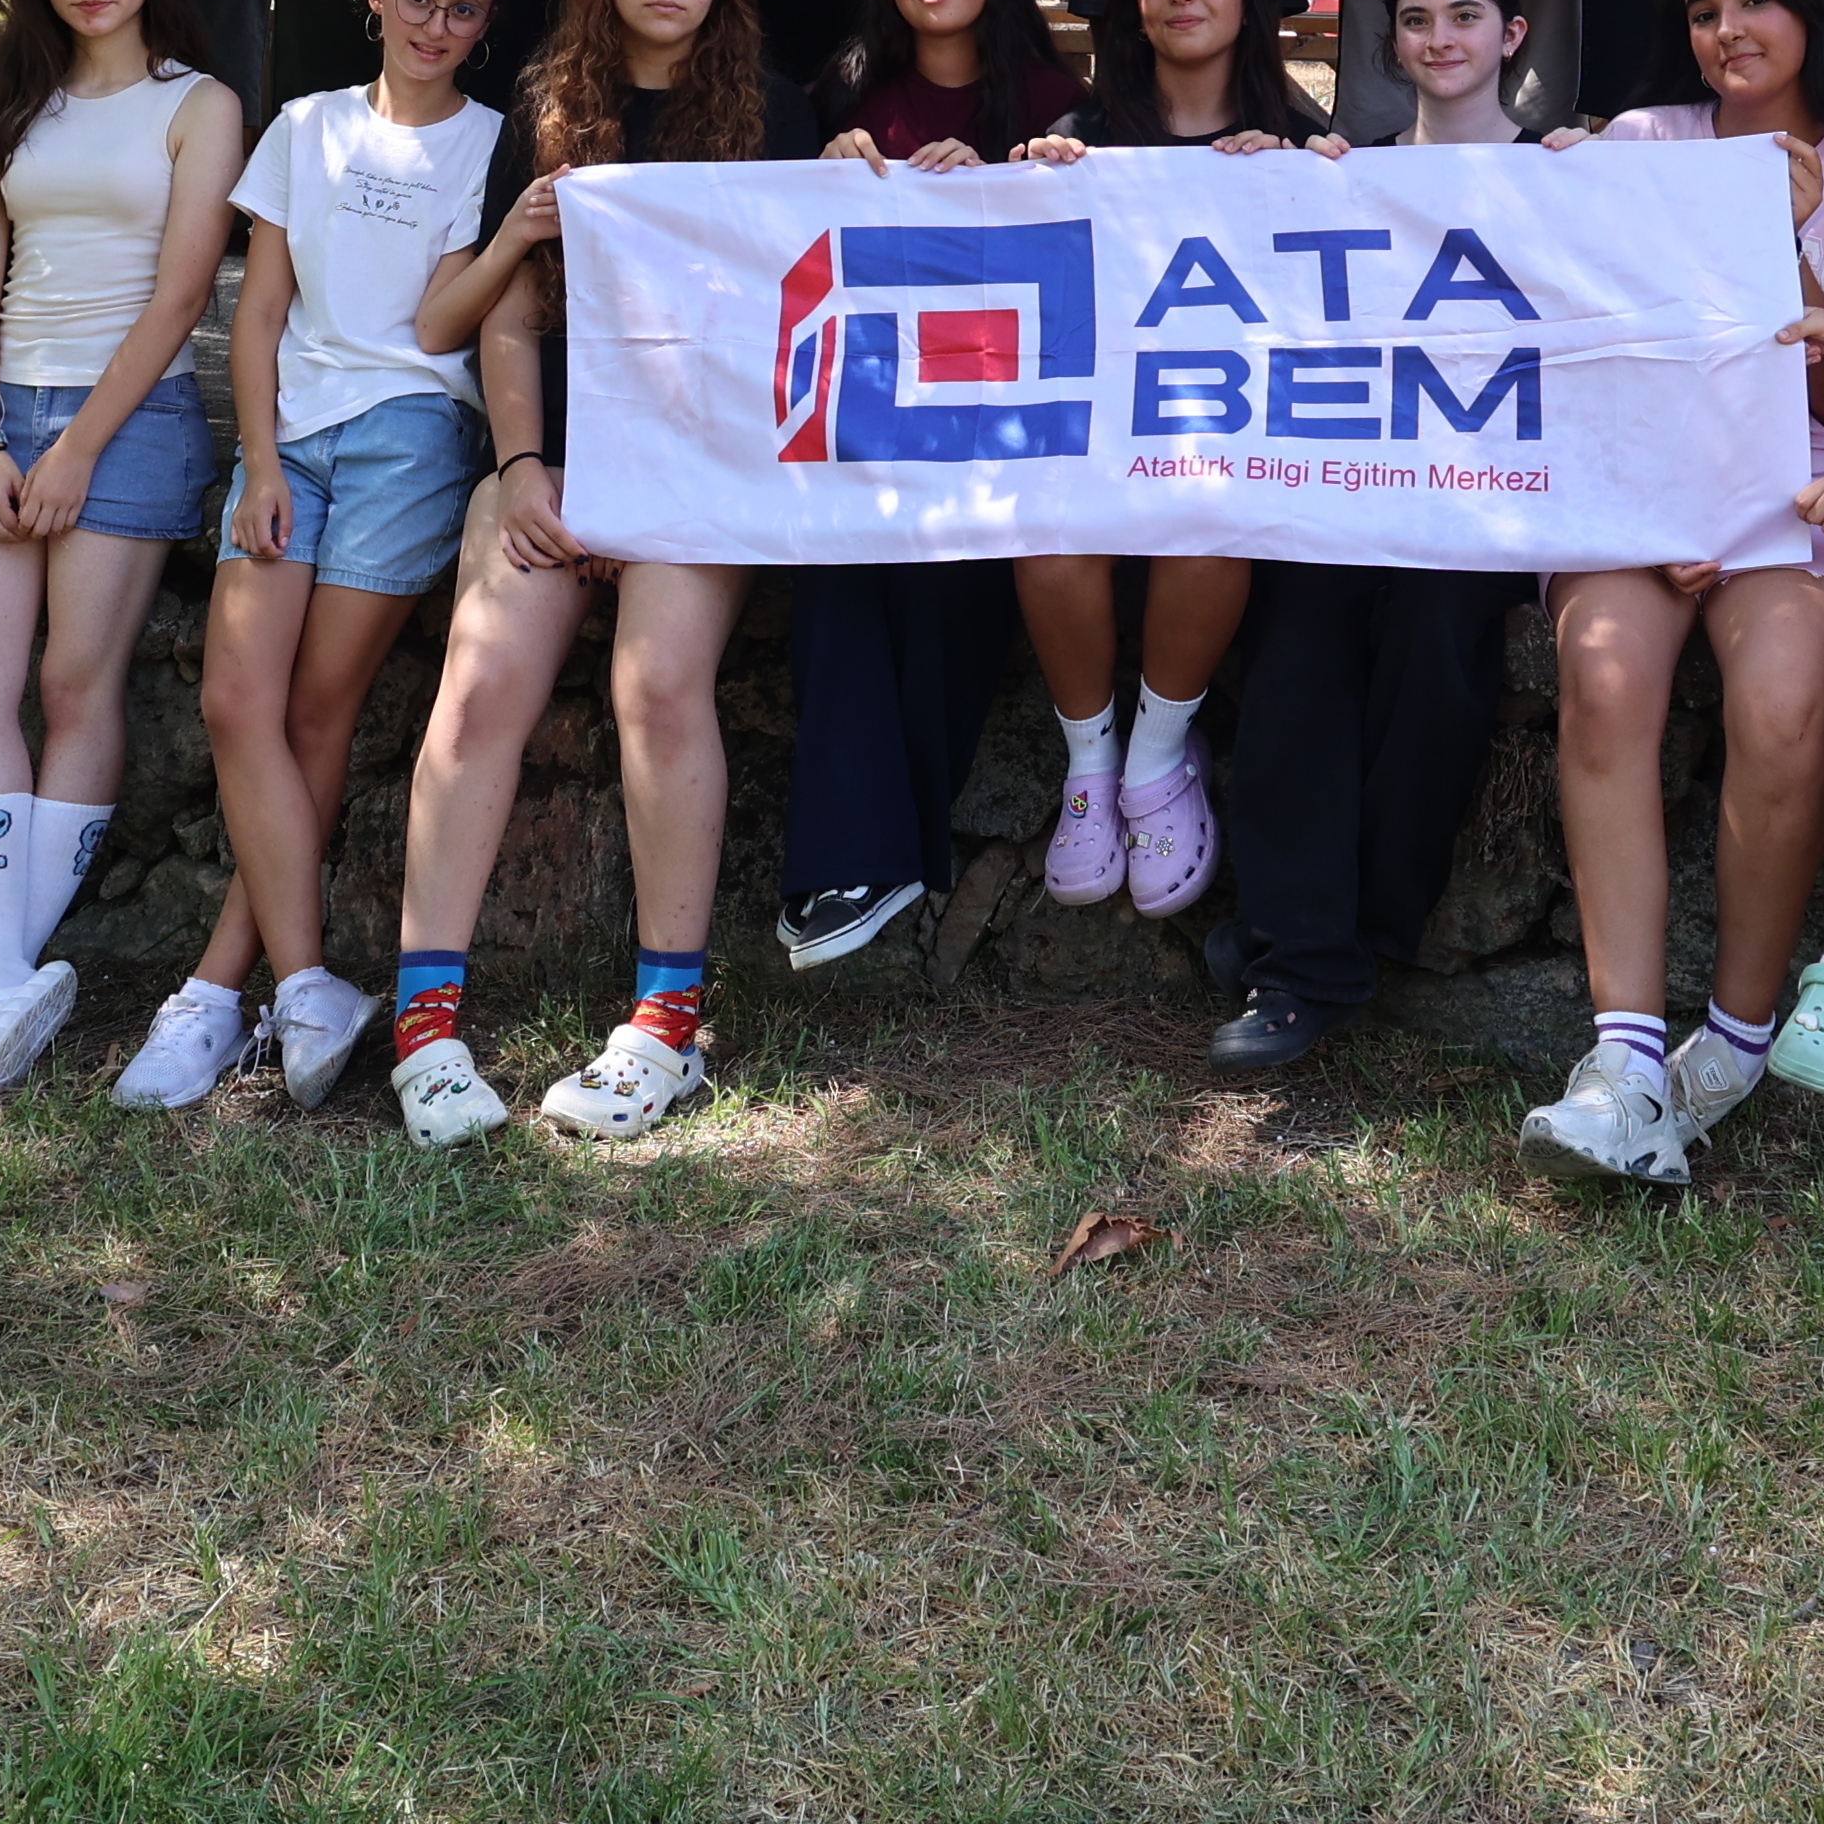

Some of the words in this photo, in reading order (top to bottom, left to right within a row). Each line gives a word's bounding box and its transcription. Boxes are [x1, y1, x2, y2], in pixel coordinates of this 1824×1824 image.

[1133, 227, 1542, 328] ATA
[1131, 345, 1542, 441] BEM
[1127, 454, 1235, 478] Atatürk
[1246, 456, 1309, 487] Bilgi
[1321, 460, 1416, 491] Eğitim
[1428, 463, 1550, 492] Merkezi
